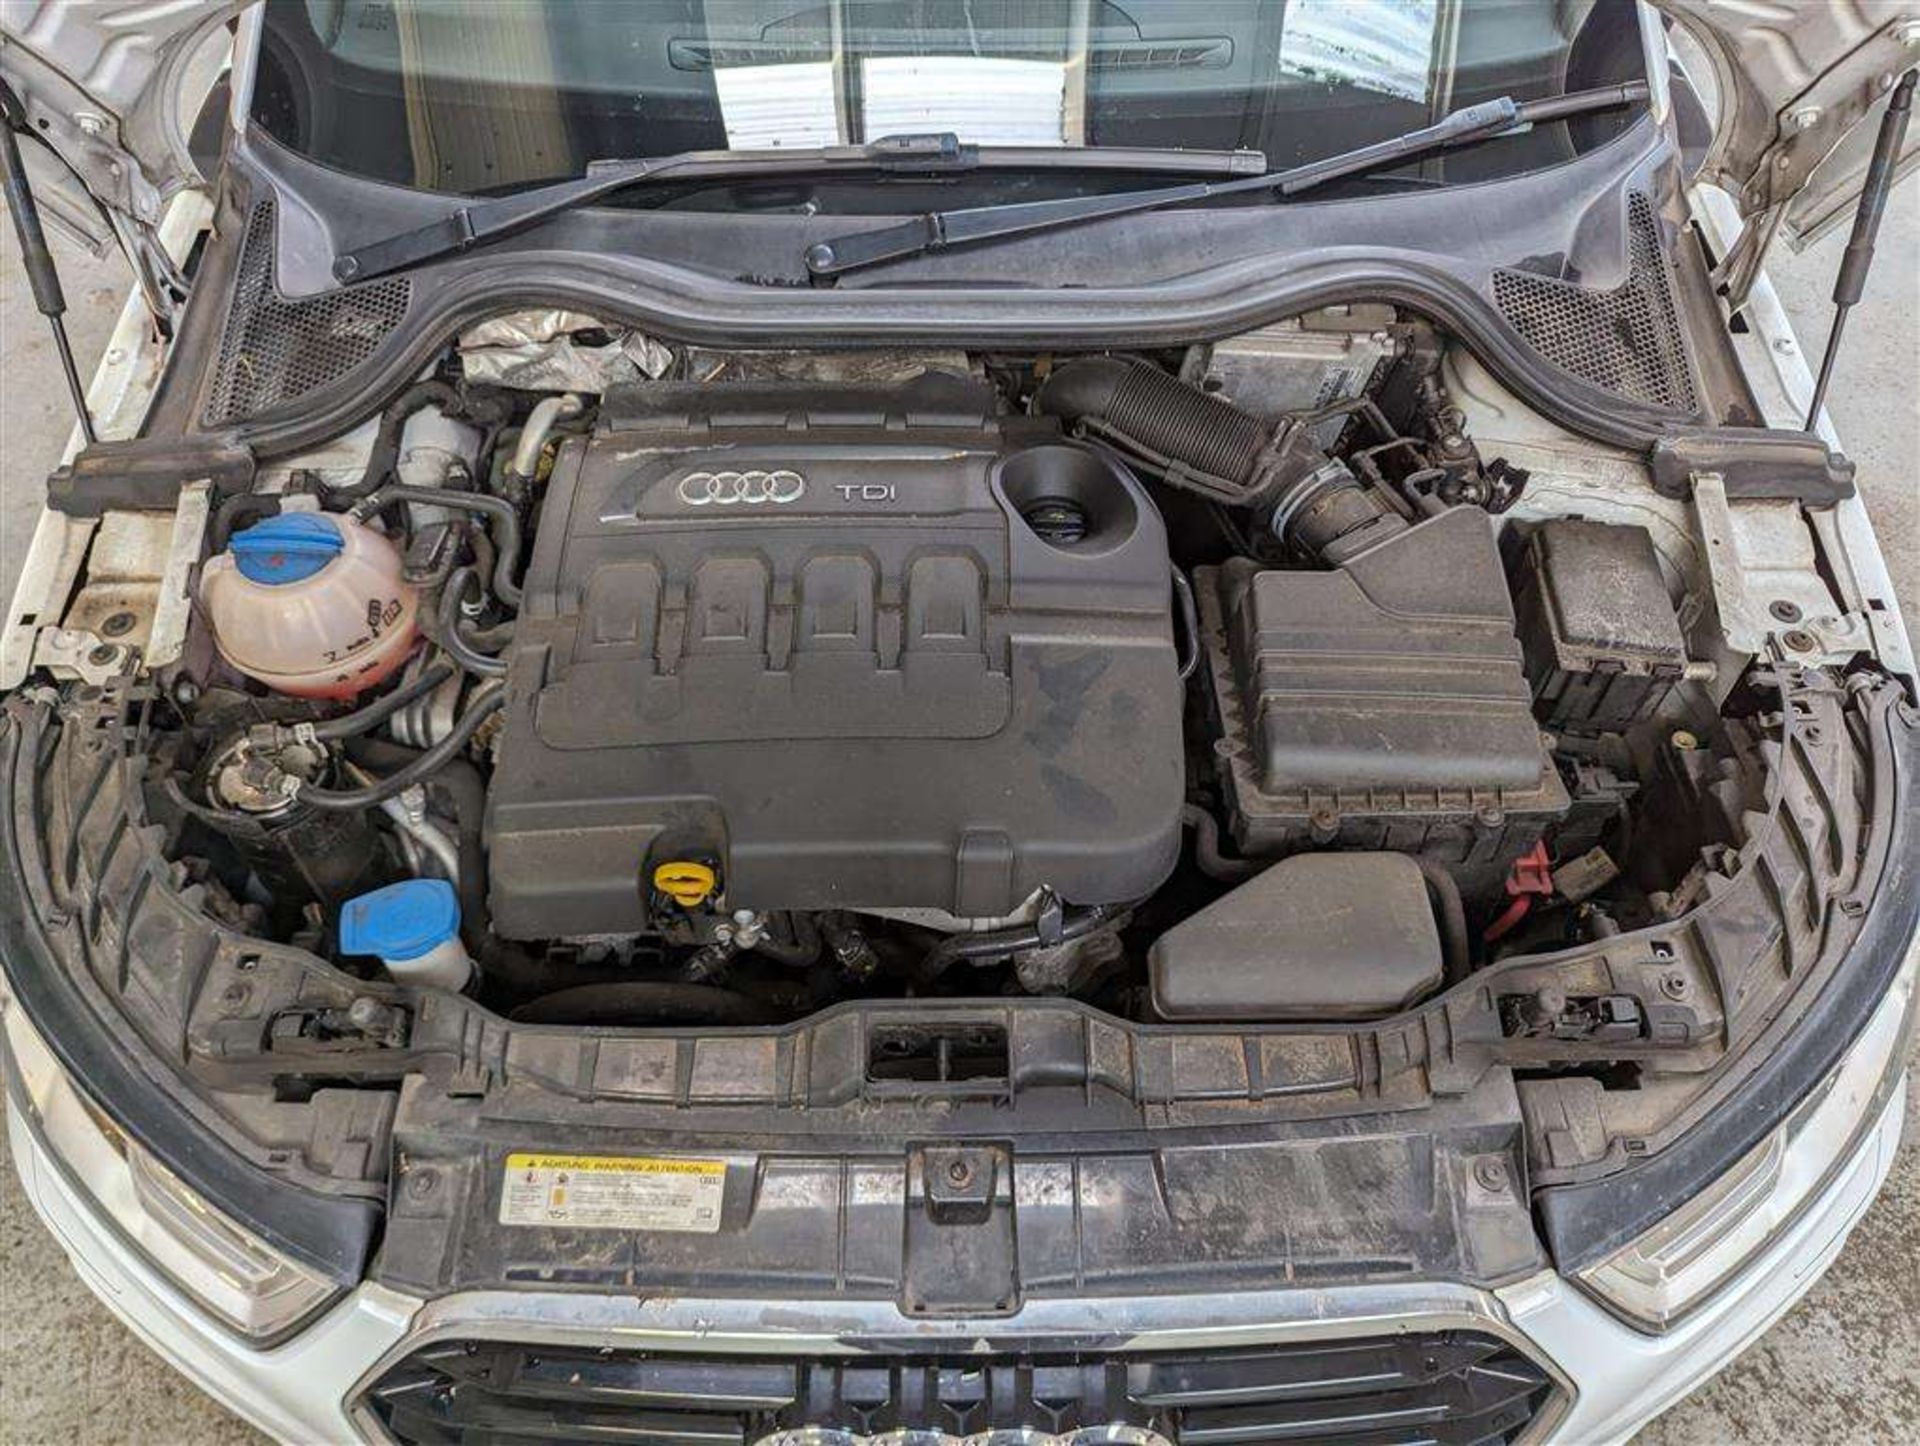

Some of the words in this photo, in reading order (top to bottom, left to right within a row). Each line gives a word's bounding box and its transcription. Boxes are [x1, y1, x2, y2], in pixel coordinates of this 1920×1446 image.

[835, 484, 895, 500] TDI
[593, 1162, 643, 1172] WARNING
[647, 1163, 702, 1173] ATTENTION
